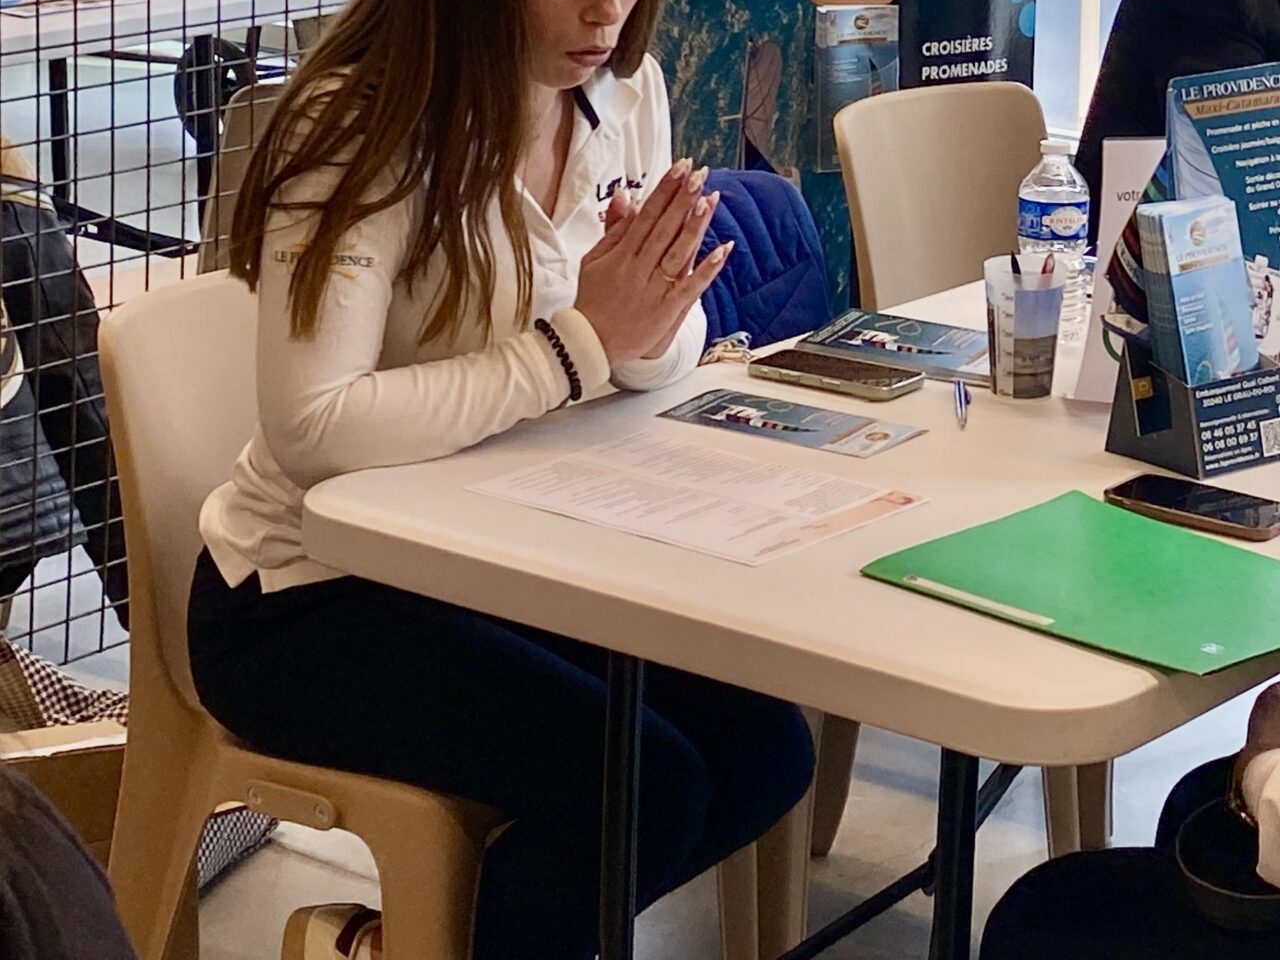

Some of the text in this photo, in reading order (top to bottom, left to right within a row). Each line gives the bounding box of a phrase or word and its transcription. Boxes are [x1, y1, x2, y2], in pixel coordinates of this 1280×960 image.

[922, 34, 993, 57] CROISIÈRES
[921, 57, 1008, 81] PROMENADES
[1181, 85, 1200, 101] LE
[1116, 190, 1140, 201] votr
